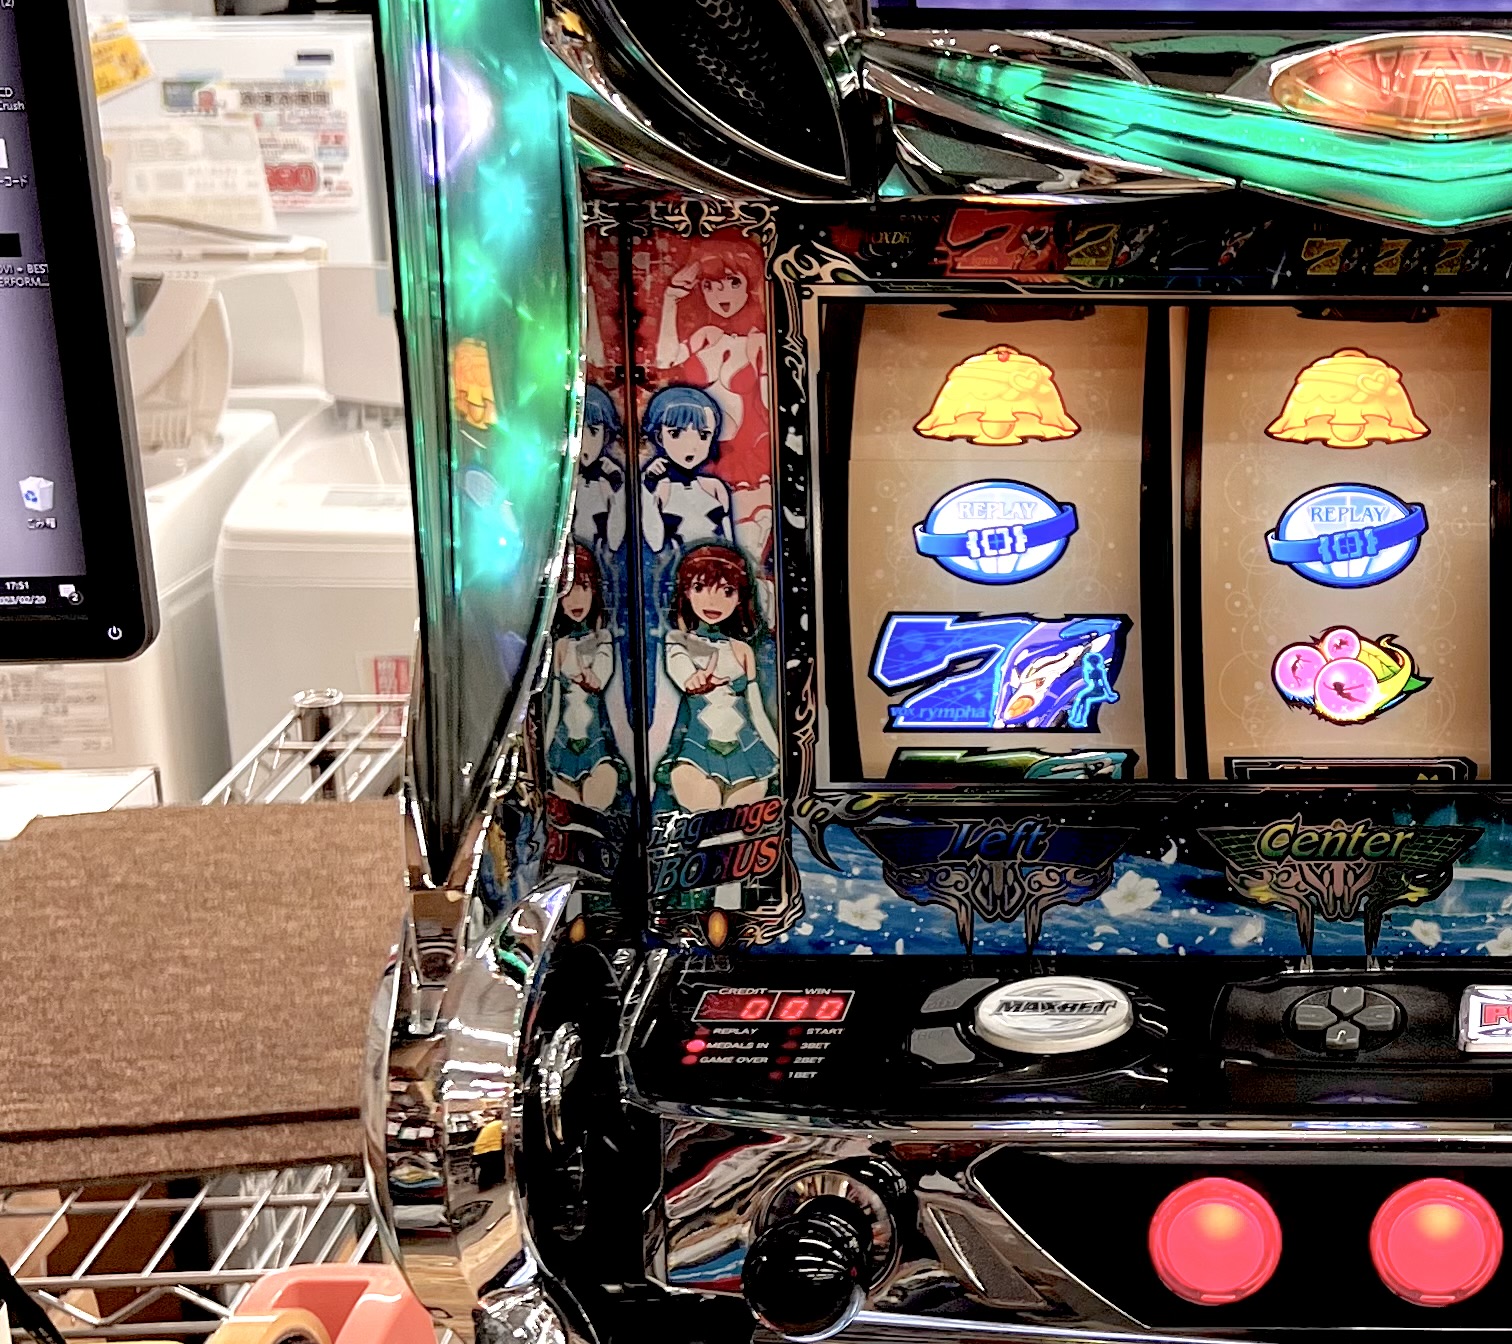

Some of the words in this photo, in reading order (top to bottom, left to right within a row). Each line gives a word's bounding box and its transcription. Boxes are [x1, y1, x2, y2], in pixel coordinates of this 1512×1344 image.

[958, 500, 1037, 520] REPLAY
[1309, 504, 1387, 524] REPLAY
[918, 703, 986, 720] rympha
[954, 819, 1053, 858] Left
[1260, 817, 1414, 860] Center
[989, 1000, 1117, 1016] MAXBET
[713, 1027, 758, 1035] REPLAY
[806, 1027, 844, 1035] START
